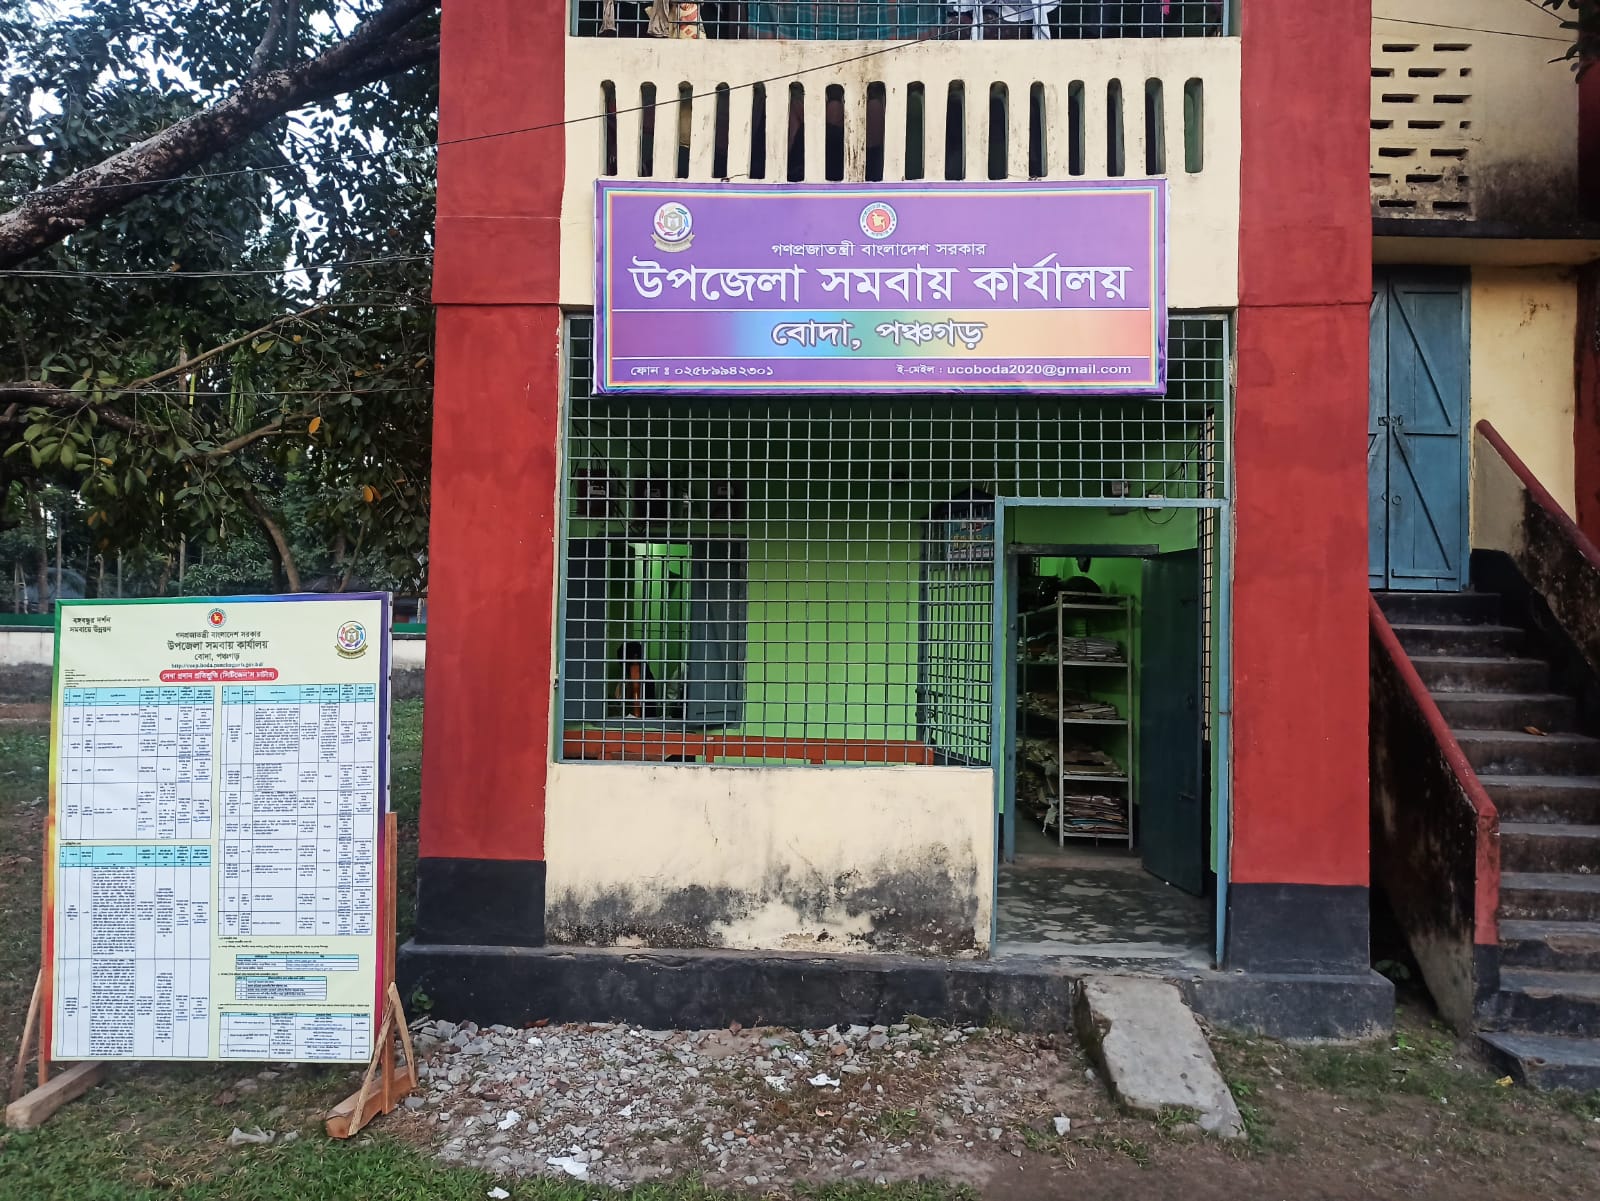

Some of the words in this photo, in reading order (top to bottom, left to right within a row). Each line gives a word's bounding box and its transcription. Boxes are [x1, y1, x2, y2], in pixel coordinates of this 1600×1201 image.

[771, 240, 855, 257] গণপ্রজাতন্ত্রী
[860, 243, 930, 258] বাংলাদেশ
[936, 242, 987, 257] সরকার
[627, 256, 807, 303] উপজেলা
[816, 263, 960, 303] সমবায়
[969, 253, 1133, 303] কার্যালয়
[771, 319, 863, 351] বোদা,
[875, 319, 988, 350] পঞ্চগড়
[630, 365, 660, 376] ফোন
[675, 365, 775, 377] ০২৫৮৯৯৪২৩০১
[896, 363, 935, 375] ই-মেইল
[947, 364, 1132, 377] ucoboda2020@gmail.com
[241, 630, 262, 638] সরকার
[167, 640, 204, 651] উপজেলা
[206, 640, 235, 650] সমবায়
[236, 638, 270, 650] কার্যালয়
